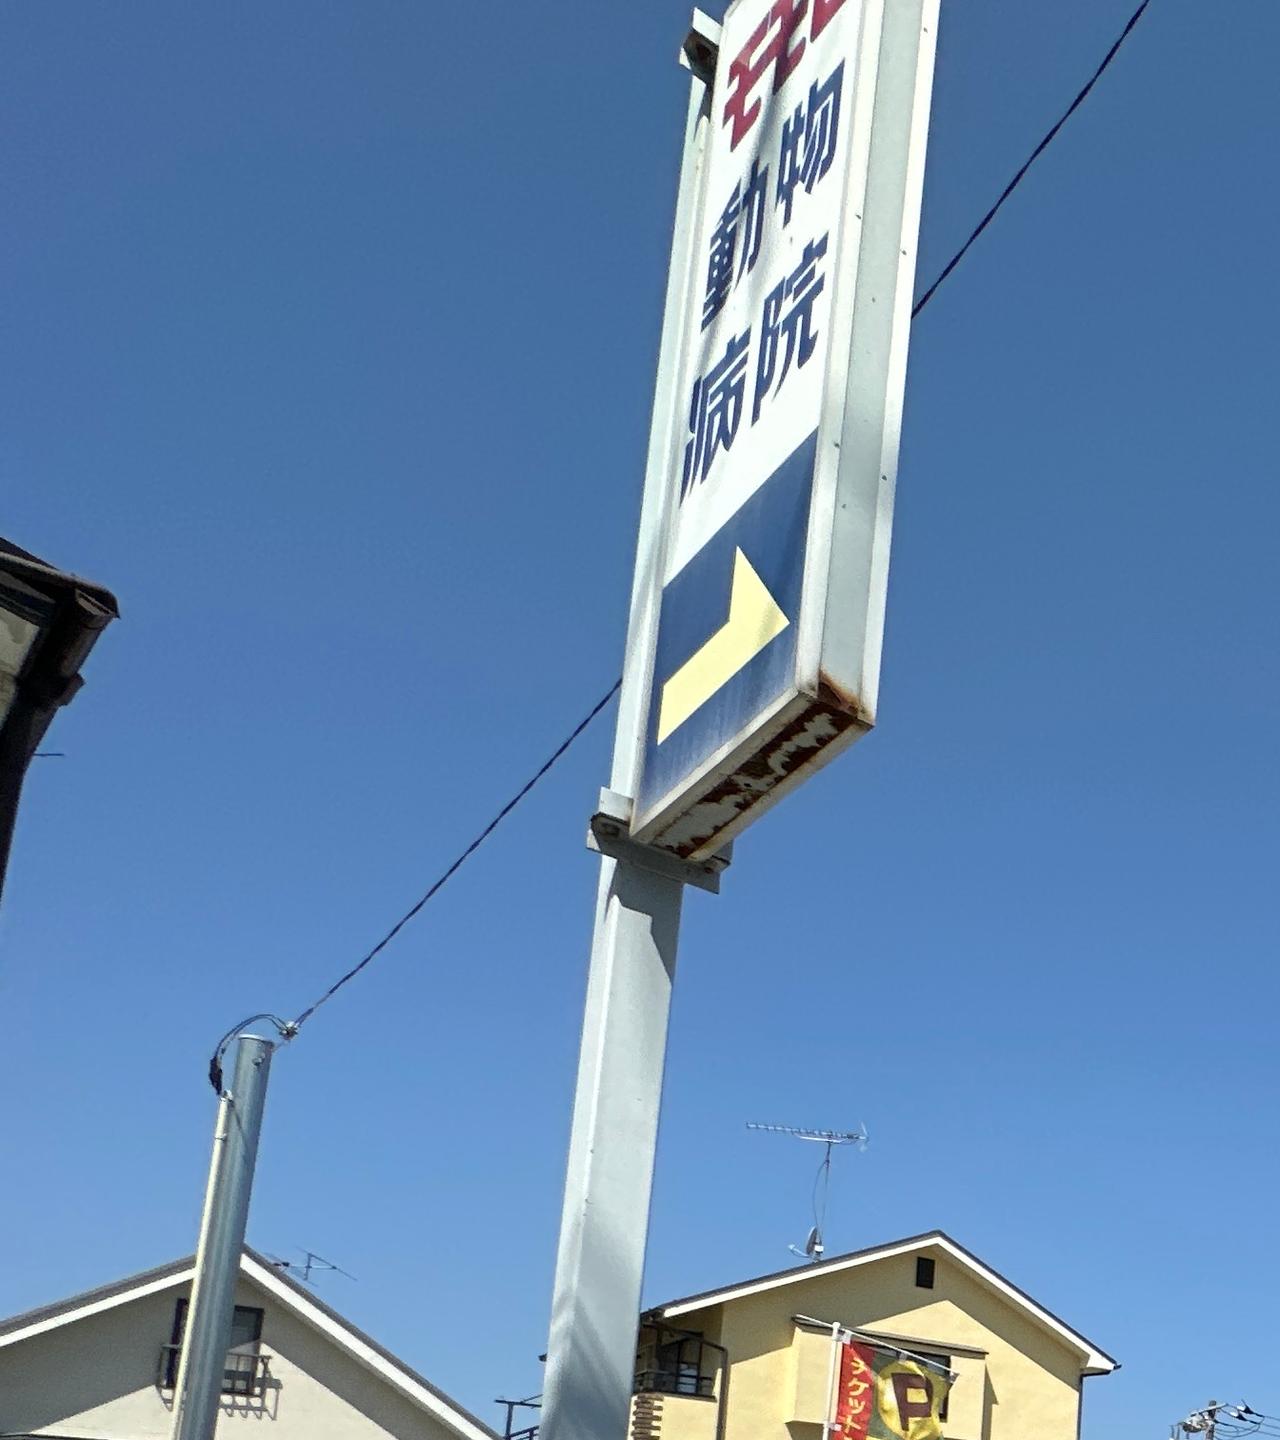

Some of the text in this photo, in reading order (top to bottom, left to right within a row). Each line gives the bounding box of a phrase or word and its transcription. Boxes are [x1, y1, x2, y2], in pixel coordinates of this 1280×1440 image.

[701, 57, 845, 332] 動物
[680, 230, 829, 508] 病院
[890, 1372, 934, 1432] P
